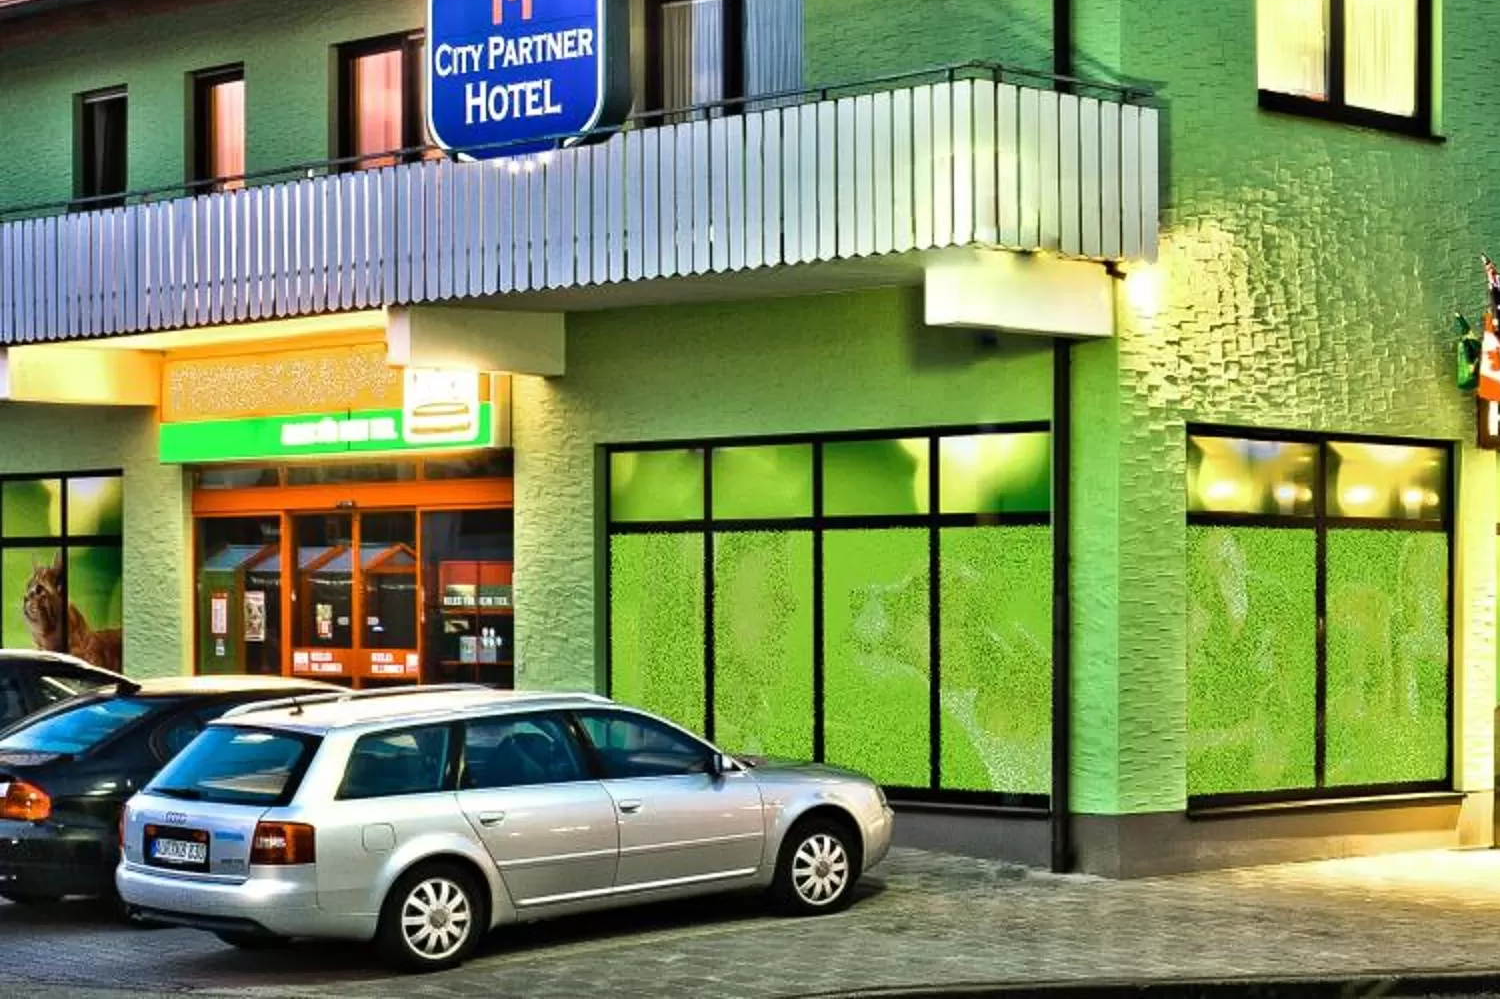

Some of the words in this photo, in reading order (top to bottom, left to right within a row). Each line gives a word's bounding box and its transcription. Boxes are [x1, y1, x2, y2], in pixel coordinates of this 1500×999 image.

[434, 43, 484, 77] CITY
[488, 28, 594, 70] PARTNER
[465, 78, 563, 125] HOTEL
